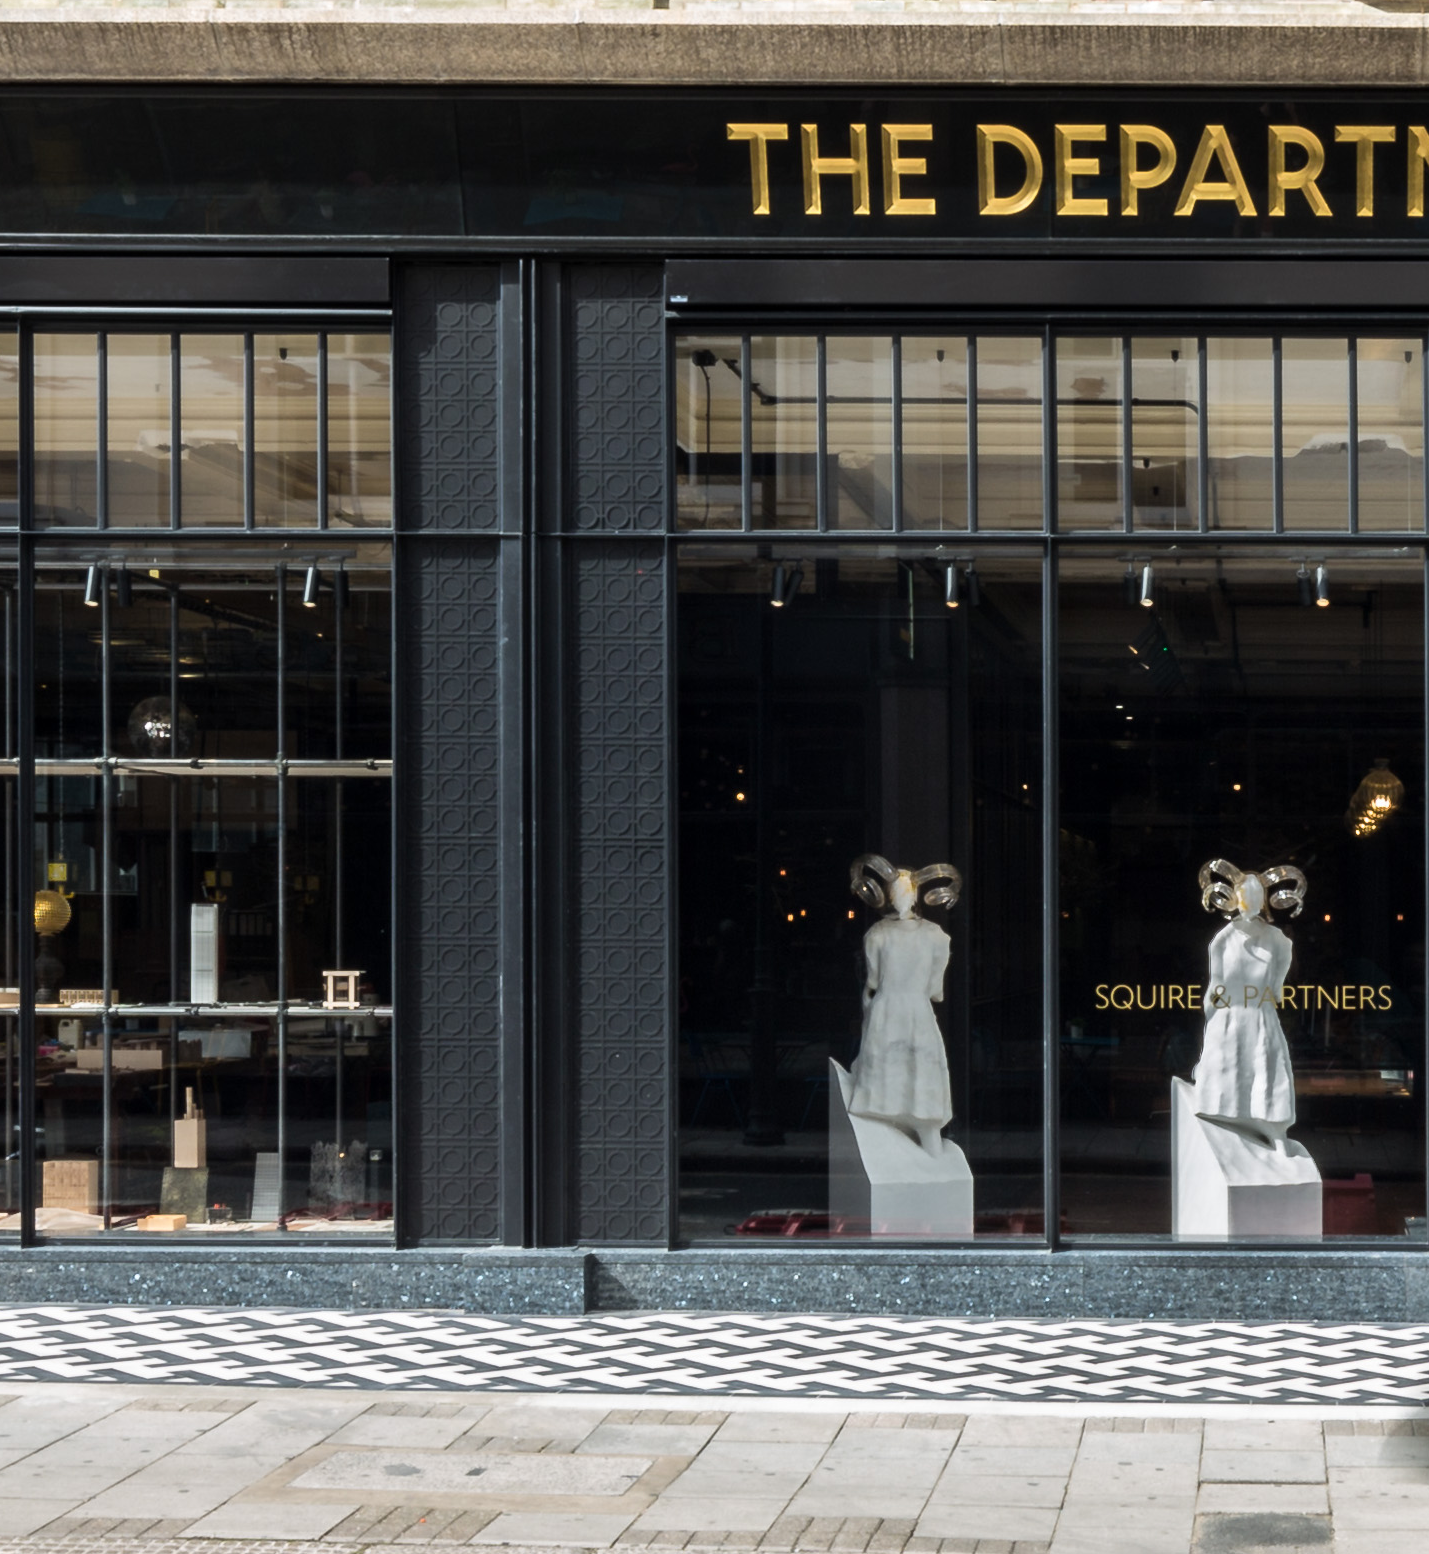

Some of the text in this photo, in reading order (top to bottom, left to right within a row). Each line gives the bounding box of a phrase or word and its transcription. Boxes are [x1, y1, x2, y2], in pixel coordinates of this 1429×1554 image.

[726, 123, 936, 215] THE
[1095, 984, 1393, 1011] SQUIRE & PARTNERS
